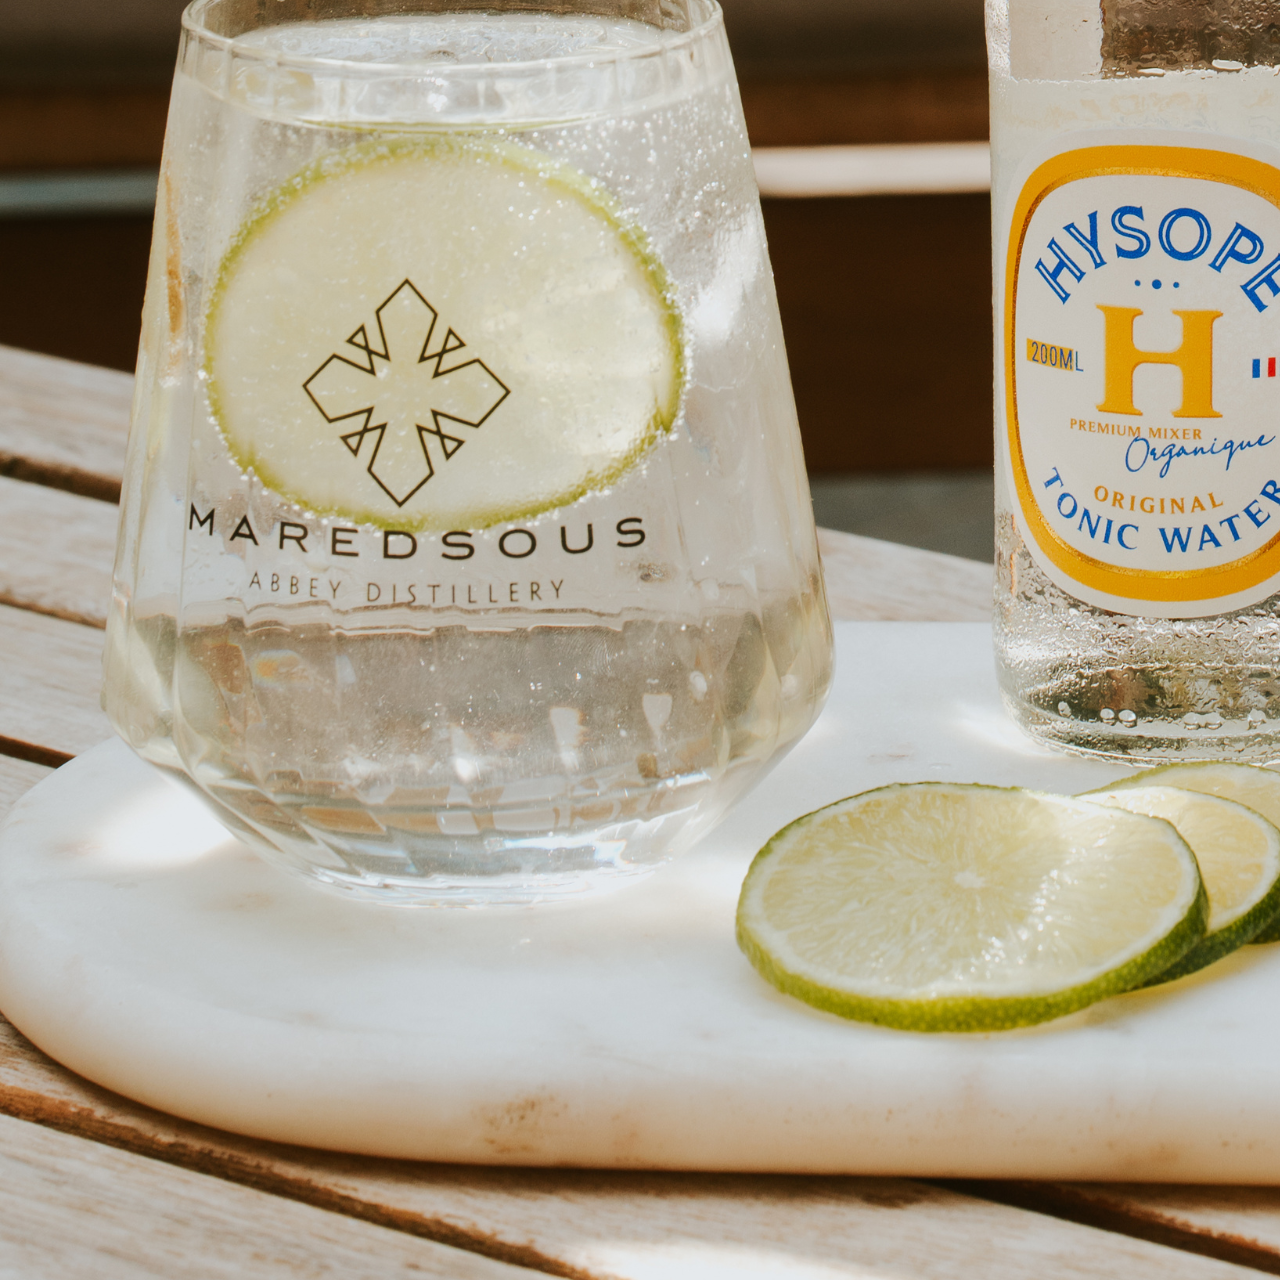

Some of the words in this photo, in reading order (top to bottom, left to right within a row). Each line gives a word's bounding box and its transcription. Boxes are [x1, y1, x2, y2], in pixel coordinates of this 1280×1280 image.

[1031, 340, 1085, 372] 200ML
[1095, 303, 1223, 418] H
[1069, 417, 1142, 439] PREMIUM
[1147, 425, 1203, 441] MIXER
[1124, 433, 1277, 479] Organique
[1042, 467, 1140, 551] TONIC
[1094, 485, 1224, 515] ORIGINAL
[188, 502, 647, 560] MAREDSOUS
[248, 570, 342, 600] ABBEY
[366, 579, 565, 605] DISTILLERY
